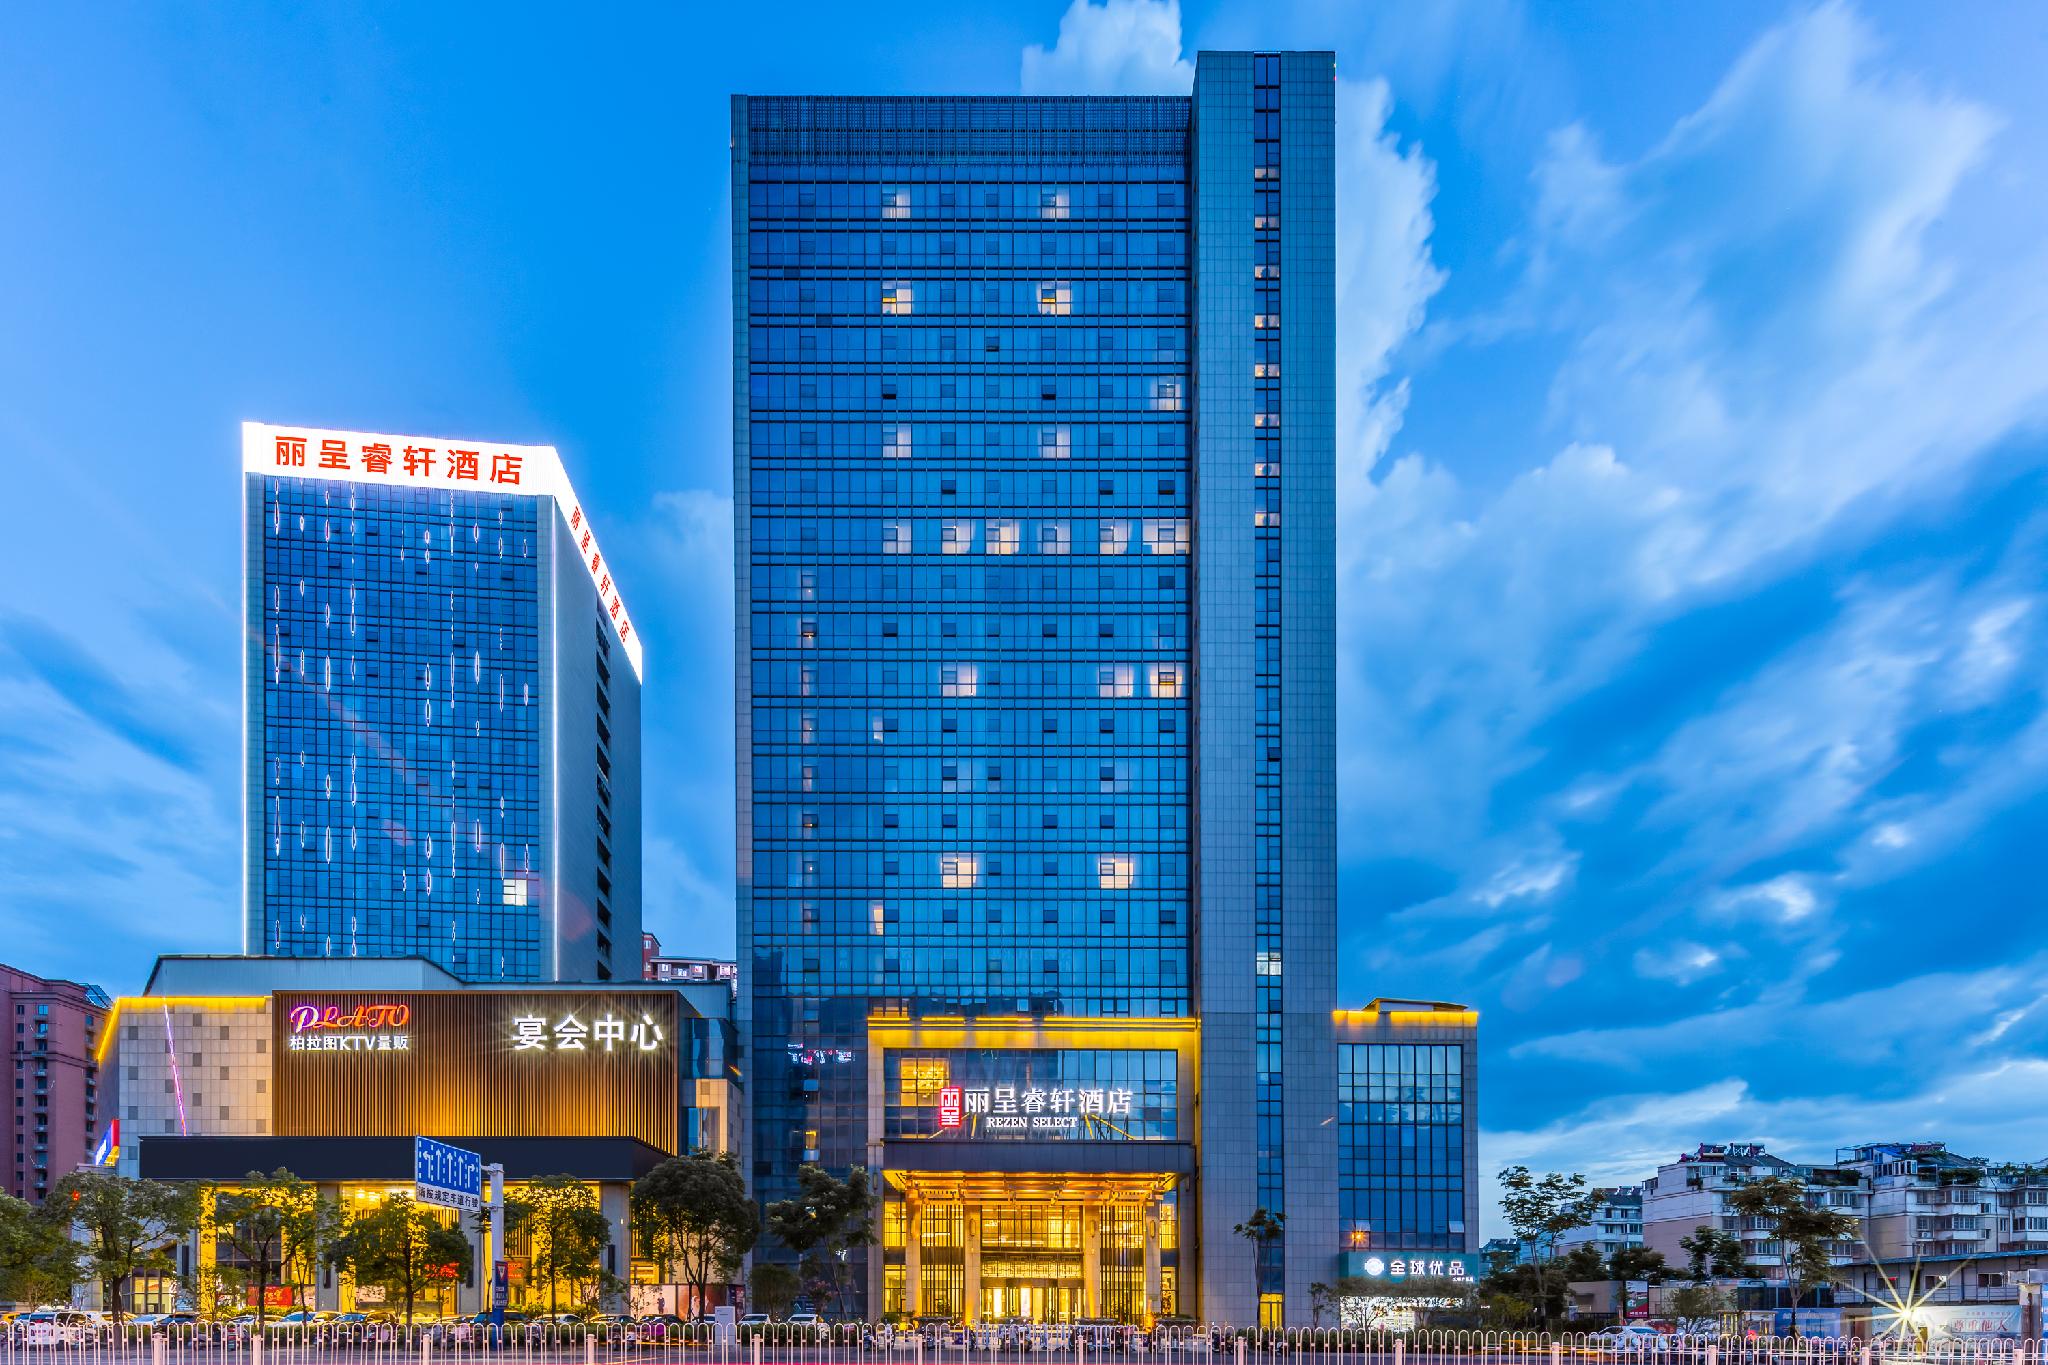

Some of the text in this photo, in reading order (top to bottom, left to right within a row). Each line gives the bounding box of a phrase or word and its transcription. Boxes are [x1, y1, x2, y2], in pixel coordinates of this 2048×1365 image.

[275, 435, 523, 485] 丽呈睿轩酒店
[290, 1004, 409, 1033] PLATO
[289, 1035, 409, 1051] 柏拉图KTV量贩
[512, 1014, 663, 1051] 宴会中心
[964, 1088, 1134, 1114] 丽呈睿轩酒店
[986, 1117, 1078, 1128] REZEN SELECT
[1390, 1260, 1465, 1276] 全球优品
[1954, 1319, 2008, 1332] 尊重他人
